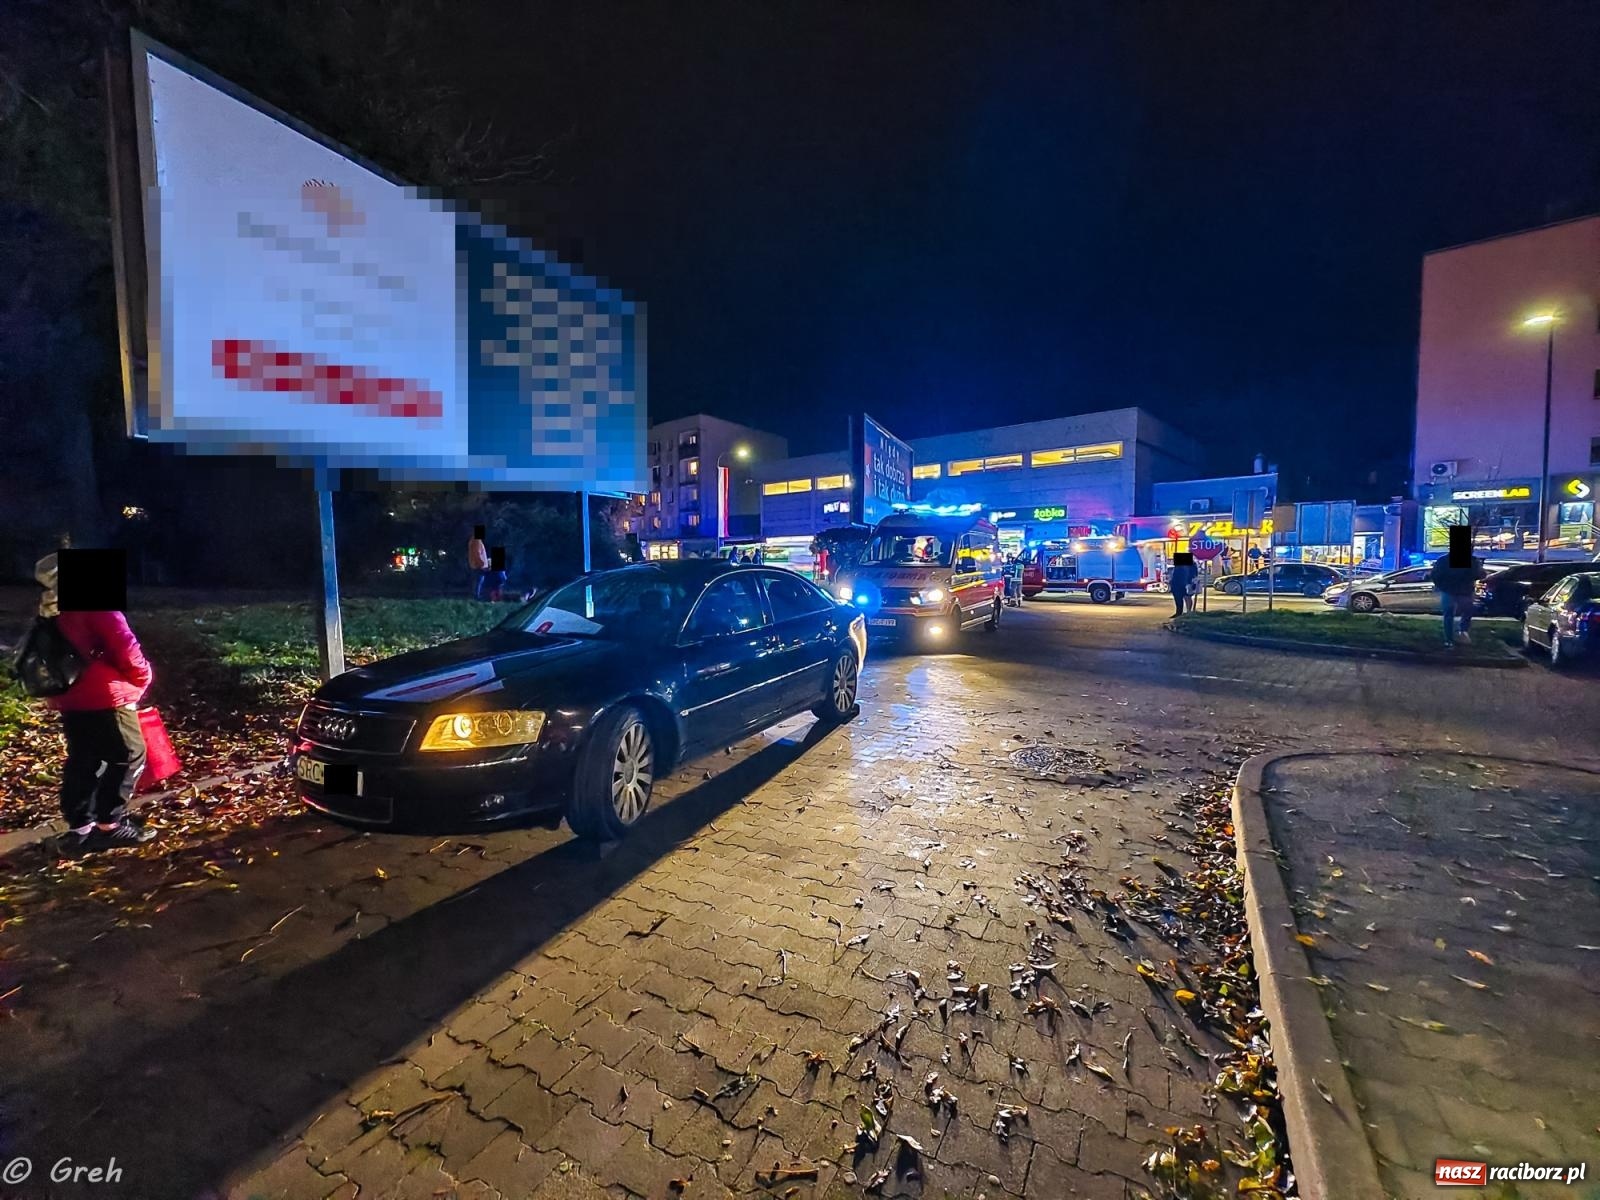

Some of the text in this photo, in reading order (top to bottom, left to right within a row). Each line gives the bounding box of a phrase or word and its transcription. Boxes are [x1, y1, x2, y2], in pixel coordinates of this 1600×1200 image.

[874, 453, 905, 484] tak dobrze
[878, 478, 889, 501] tak
[1453, 488, 1529, 500] SCREENLAB
[1191, 540, 1221, 550] STOP
